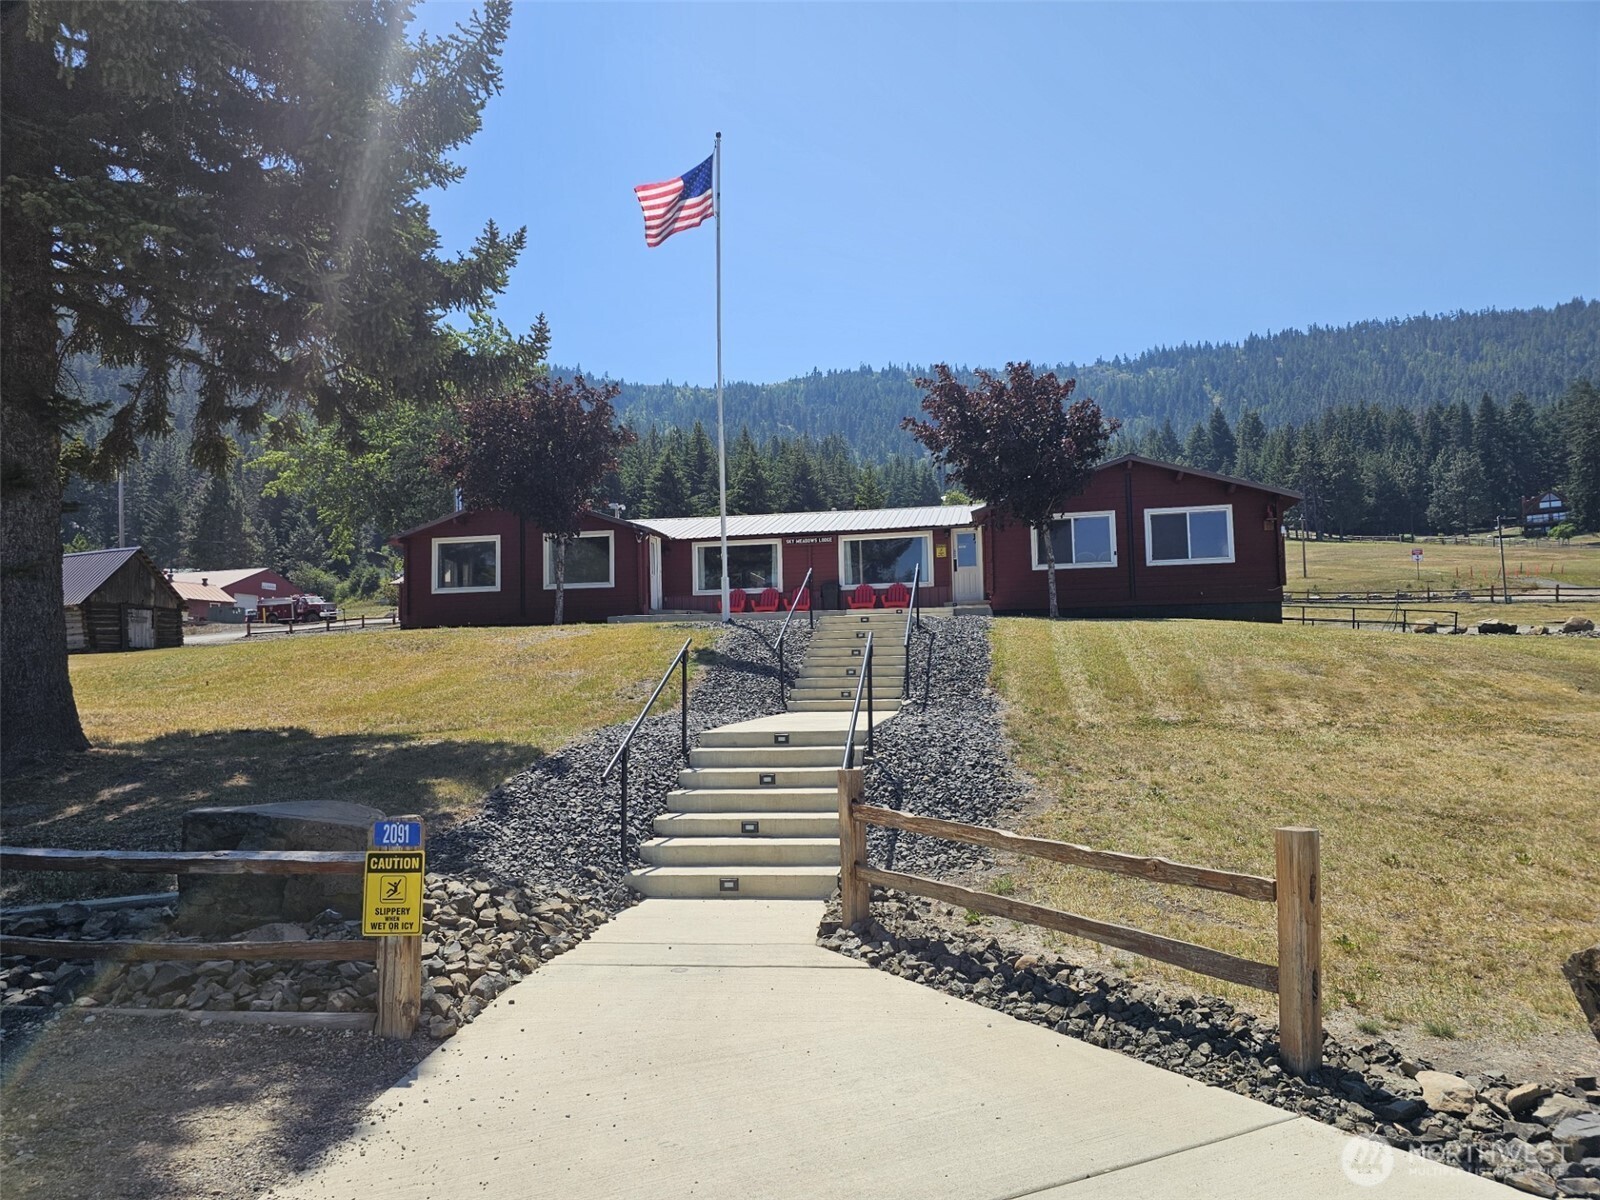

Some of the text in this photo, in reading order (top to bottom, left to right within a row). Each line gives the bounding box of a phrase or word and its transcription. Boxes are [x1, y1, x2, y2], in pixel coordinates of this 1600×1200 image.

[383, 823, 409, 843] 2091
[370, 857, 420, 869] CAUTION
[375, 907, 411, 915] SLIPPERY
[370, 922, 414, 930] WET OR ICY
